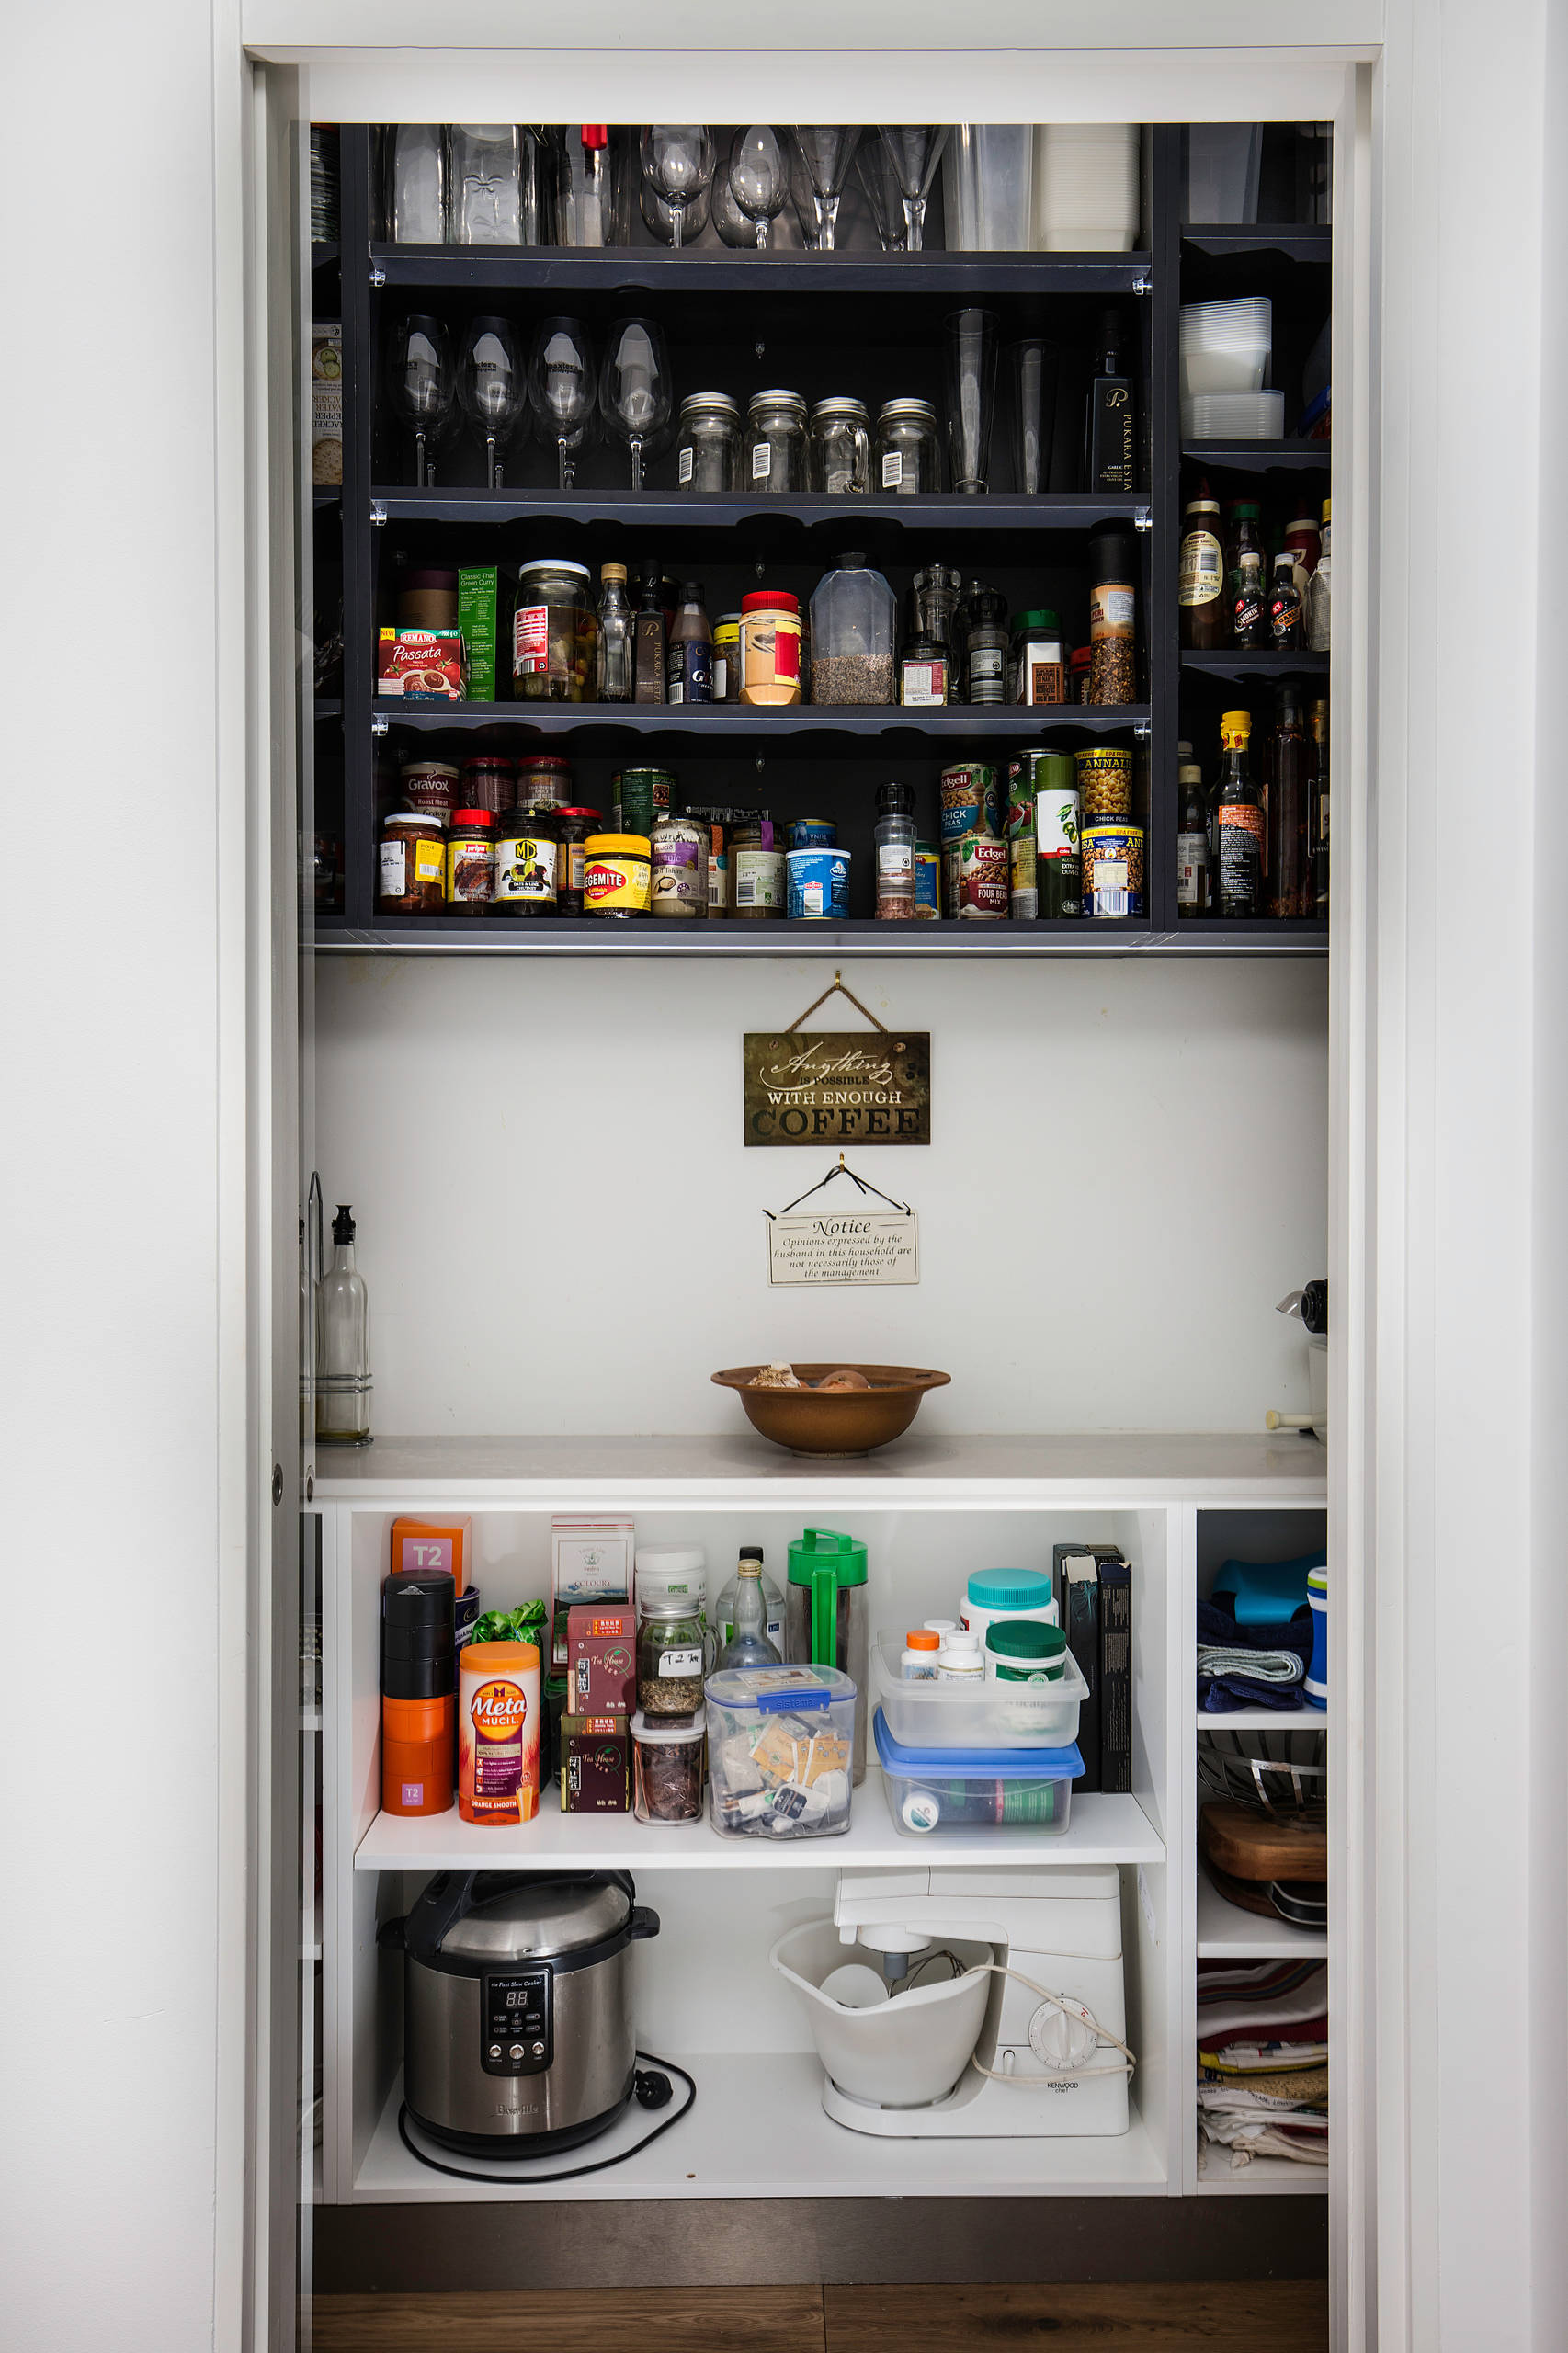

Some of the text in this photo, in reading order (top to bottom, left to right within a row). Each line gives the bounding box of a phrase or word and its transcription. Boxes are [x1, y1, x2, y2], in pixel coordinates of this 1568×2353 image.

[1123, 414, 1132, 460] PUKARA
[461, 579, 478, 587] Green
[402, 634, 436, 642] REMANO
[393, 645, 442, 663] Passata
[408, 778, 449, 792] Gravox
[941, 774, 967, 789] Edgell
[941, 809, 967, 822] CHICK
[945, 819, 961, 827] PEAS
[517, 840, 537, 860] MD
[978, 847, 1007, 860] Edgell
[978, 888, 995, 899] FOUR
[759, 1040, 893, 1091] Anything
[800, 1075, 870, 1086] IS POSSIBLE
[767, 1090, 902, 1105] WITH ENOUGH
[752, 1108, 920, 1136] COFFEE
[812, 1219, 871, 1237] Notice
[783, 1234, 903, 1248] Opinions expressed by the
[773, 1245, 912, 1257] husband in this household are
[790, 1256, 897, 1269] not necessarily those of
[804, 1268, 882, 1279] the management.
[413, 1546, 442, 1566] T2
[574, 1579, 611, 1588] COLOURY
[591, 1656, 603, 1665] Tea
[471, 1697, 528, 1718] Meta
[777, 1699, 814, 1709] sistema
[482, 1717, 517, 1726] MUCIL
[583, 1754, 594, 1763] Tea
[405, 1788, 419, 1798] T2
[471, 1800, 493, 1809] ORANGE
